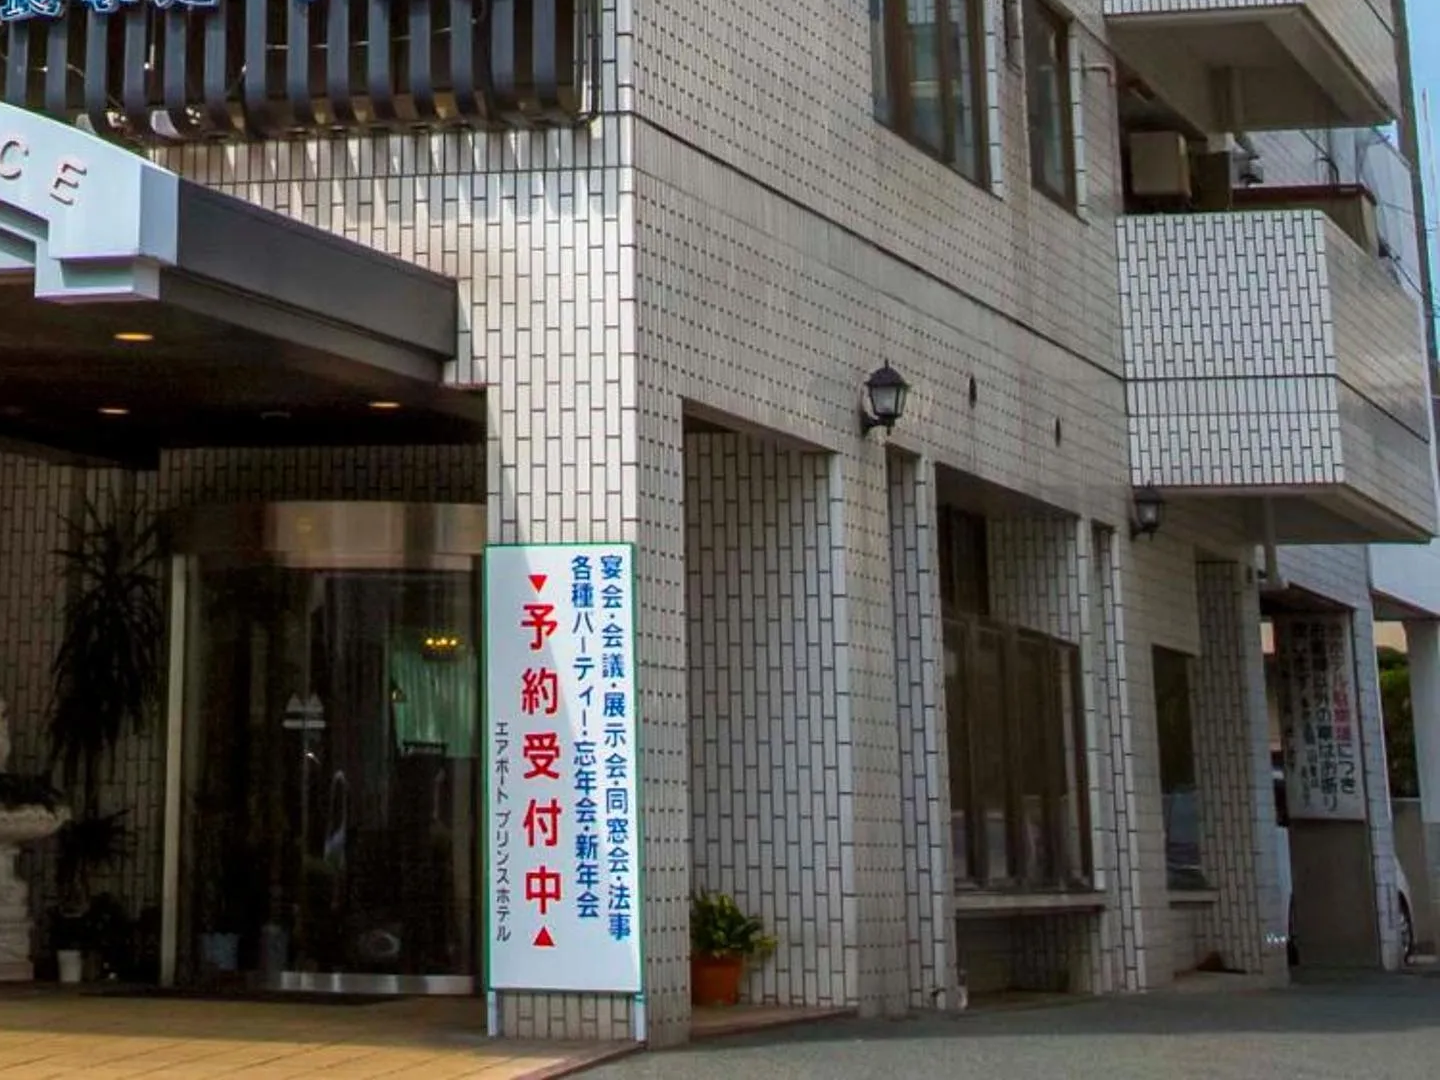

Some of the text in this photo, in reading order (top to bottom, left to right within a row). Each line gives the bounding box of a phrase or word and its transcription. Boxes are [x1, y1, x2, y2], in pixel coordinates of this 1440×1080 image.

[520, 603, 563, 916] 予約受付中
